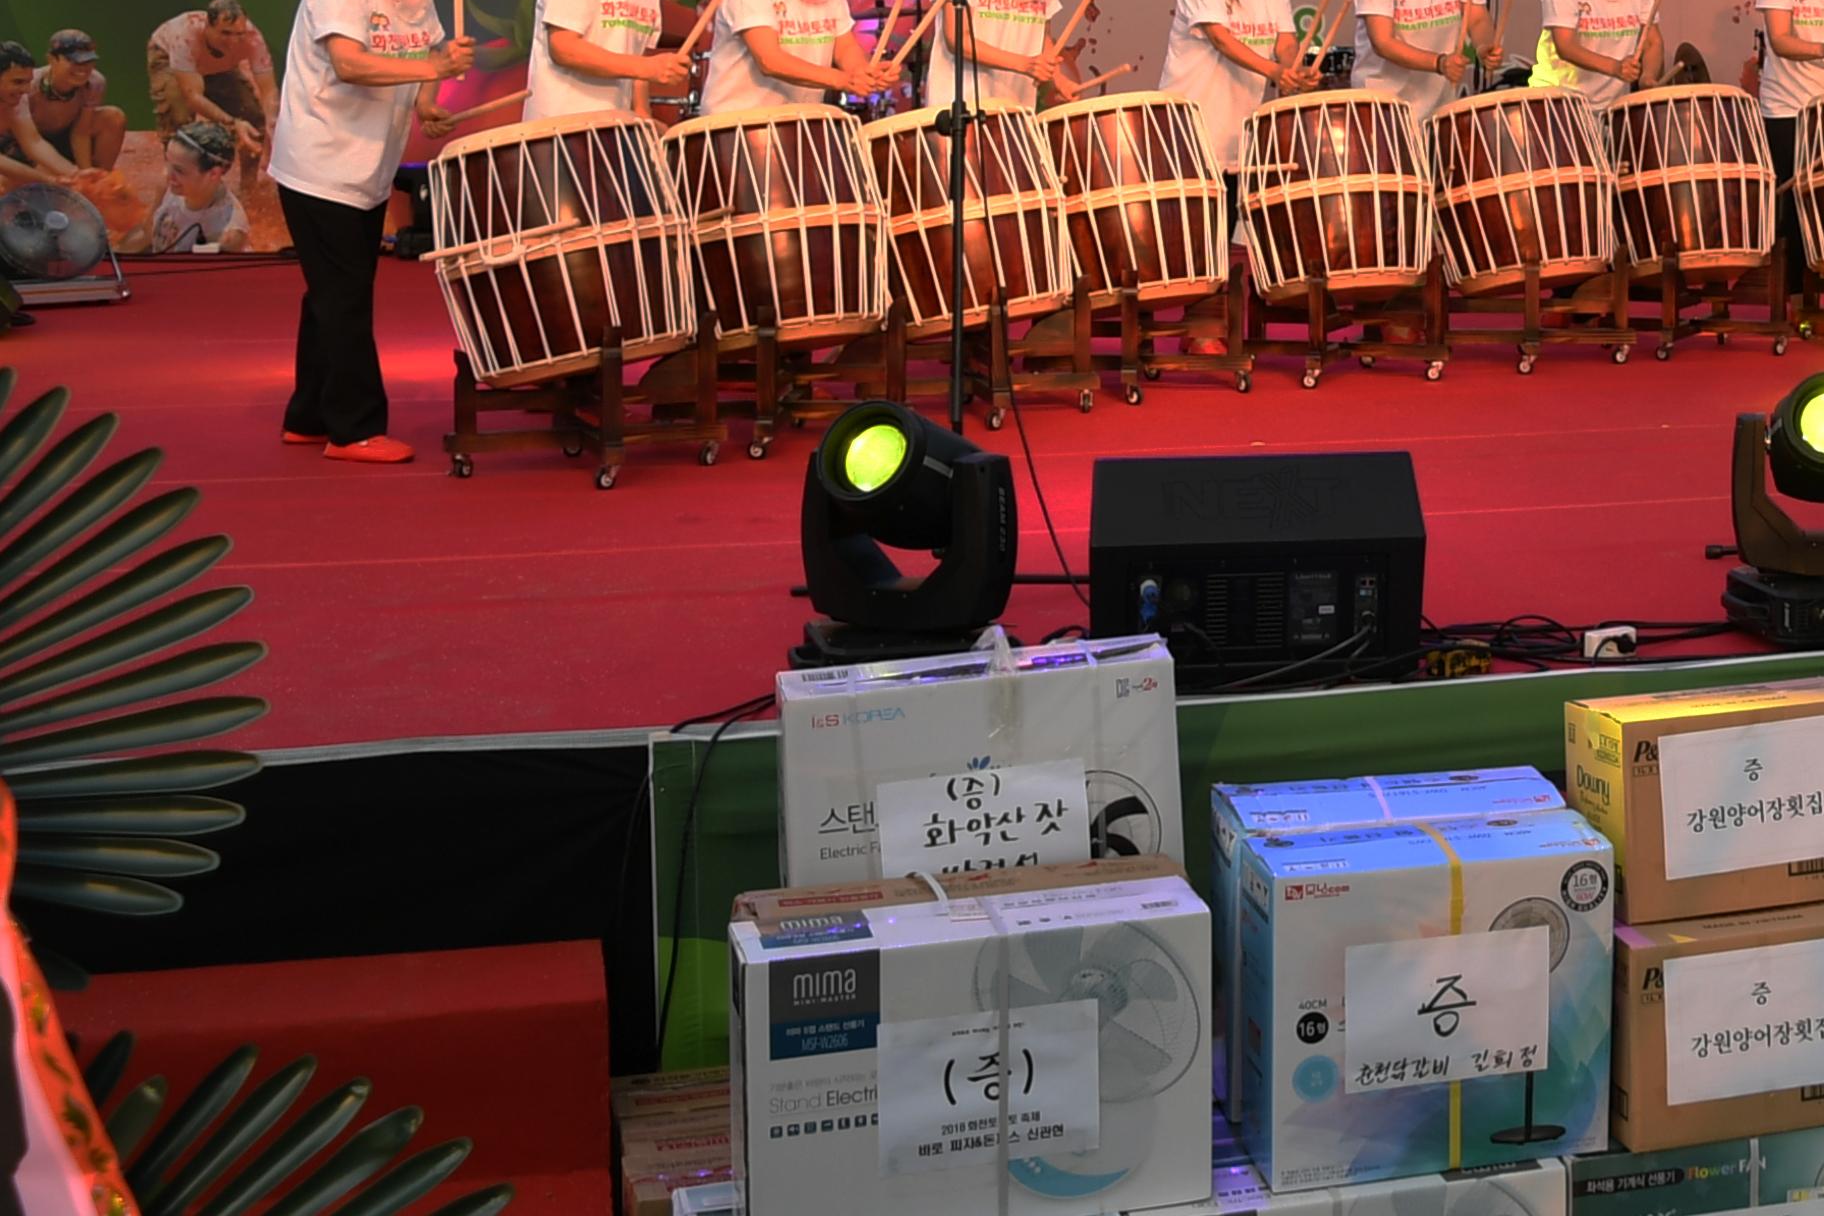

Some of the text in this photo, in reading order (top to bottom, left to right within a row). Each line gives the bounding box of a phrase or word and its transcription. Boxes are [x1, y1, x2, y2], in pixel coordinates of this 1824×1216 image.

[1744, 758, 1764, 782] 증
[946, 773, 1001, 810] (증)
[1576, 764, 1610, 806] Downy
[818, 800, 880, 834] 스탠
[1686, 790, 1824, 833] 강원양어장횟집
[923, 808, 1026, 849] 화악산
[819, 842, 867, 861] Electric
[792, 968, 857, 999] mima
[1751, 981, 1772, 1006] 증
[1417, 975, 1478, 1038] 증
[769, 1092, 822, 1115] Stand
[966, 1112, 1018, 1133] 화천토토
[918, 1141, 944, 1158] 바로
[1687, 1164, 1736, 1182] Flower
